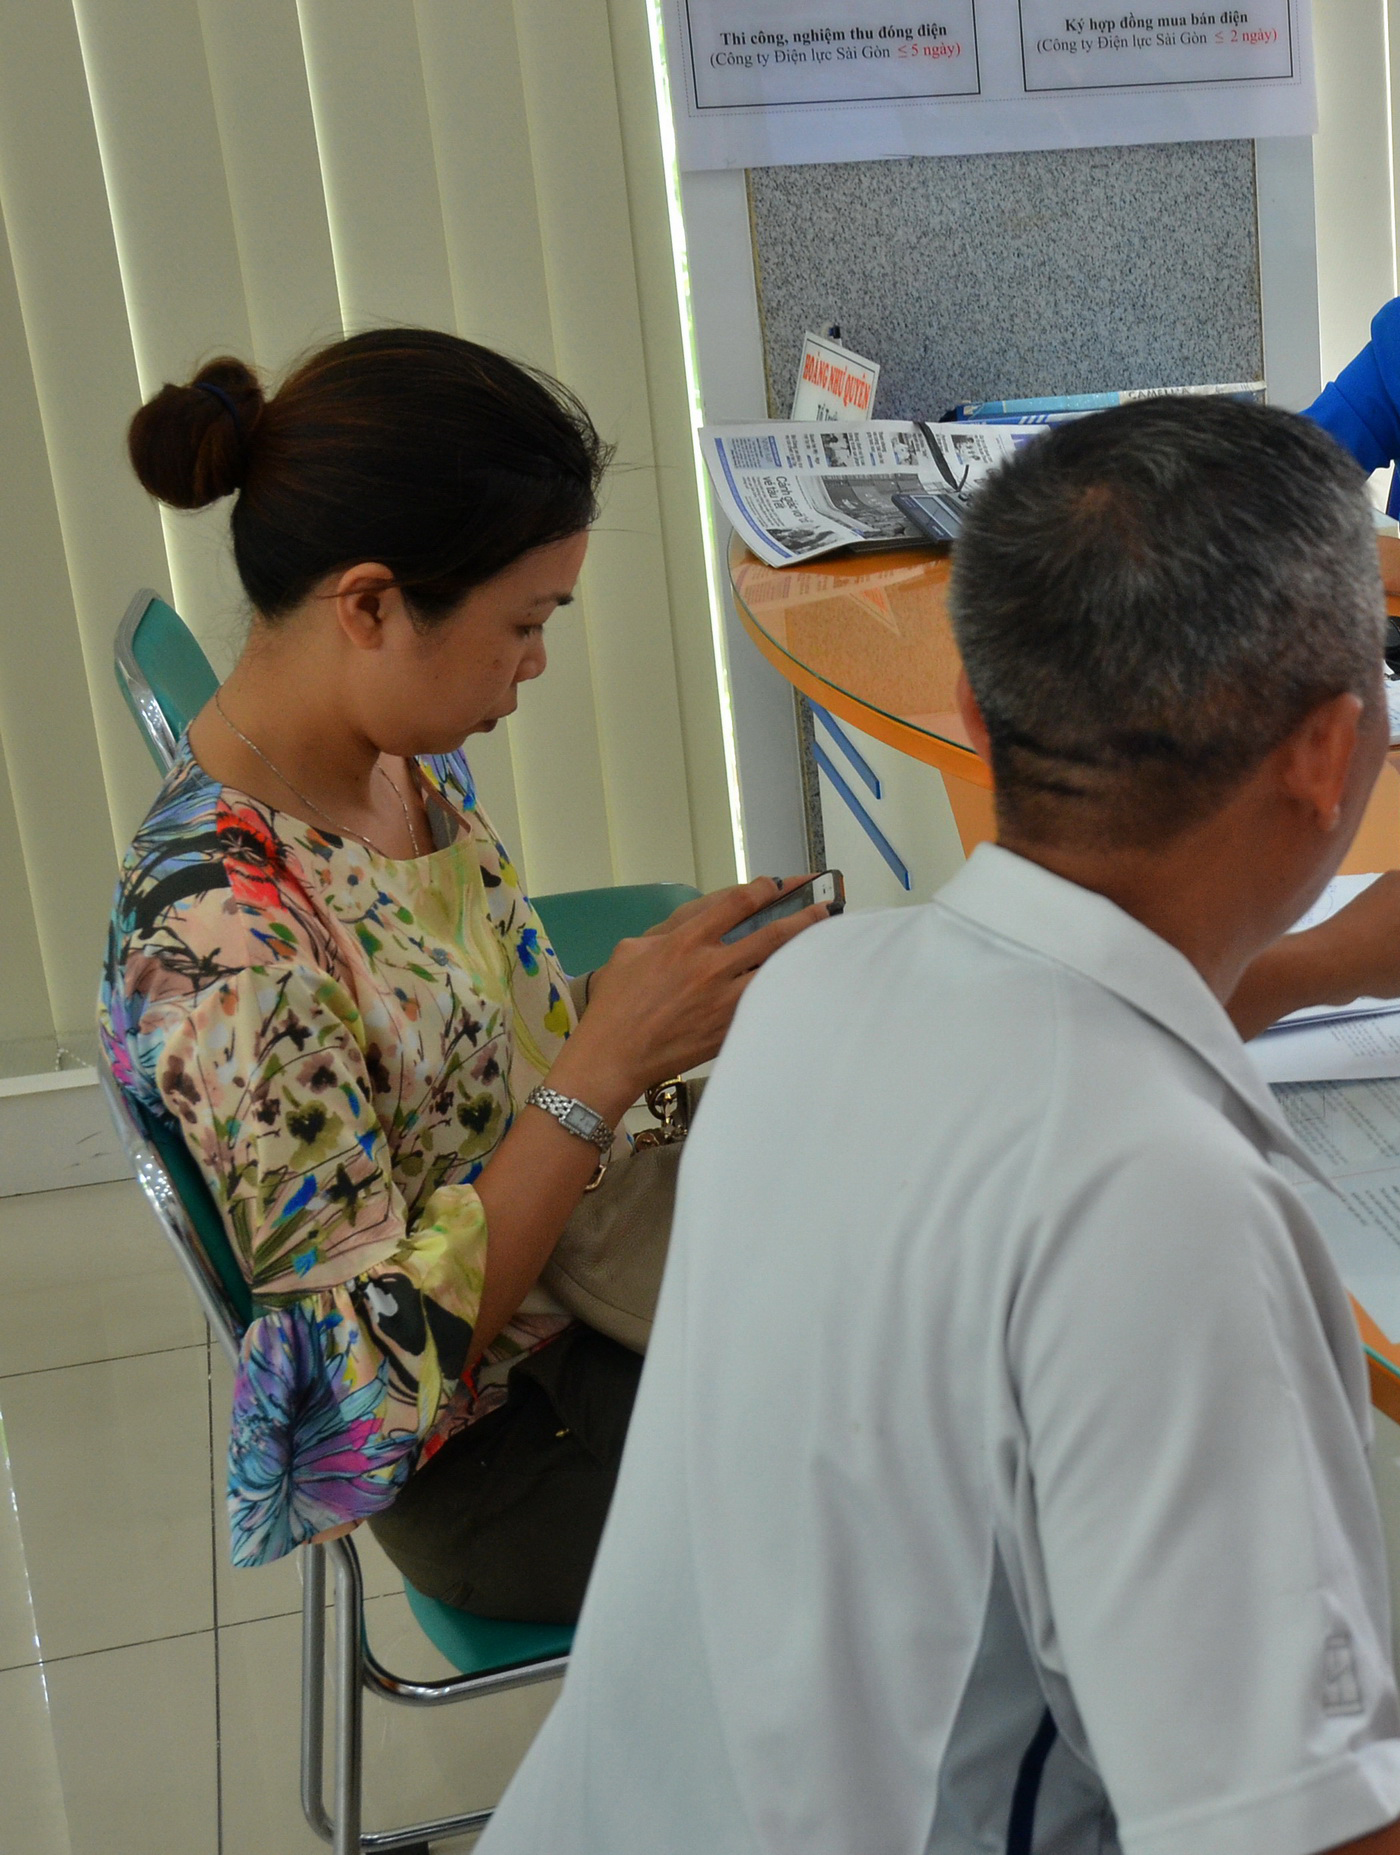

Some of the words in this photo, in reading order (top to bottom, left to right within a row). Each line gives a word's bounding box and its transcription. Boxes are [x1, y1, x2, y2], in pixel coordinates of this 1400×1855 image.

[720, 32, 746, 45] Thi
[750, 31, 789, 47] công,
[793, 28, 846, 46] nghiệm
[850, 27, 873, 40] thu
[878, 25, 914, 40] đóng
[917, 23, 947, 39] điện
[1065, 18, 1085, 34] Ký
[1089, 18, 1116, 33] hợp
[1120, 12, 1153, 31] đồng
[1157, 17, 1187, 28] mua
[1191, 12, 1216, 26] bán
[1220, 11, 1249, 27] điện
[1036, 38, 1077, 54] (Công
[1081, 38, 1093, 53] ty
[1098, 35, 1128, 51] Điện
[1132, 34, 1152, 50] lực
[1156, 32, 1176, 46] Sài
[1180, 31, 1207, 45] Gòn
[1230, 29, 1238, 43] 2
[1242, 28, 1278, 45] ngày)
[710, 49, 753, 68] (Công
[757, 52, 770, 67] ty
[774, 48, 807, 65] Điện
[811, 47, 832, 64] lực
[836, 46, 858, 60] Sài
[861, 45, 891, 59] Gòn
[911, 43, 919, 57] 5
[923, 42, 962, 59] ngày)
